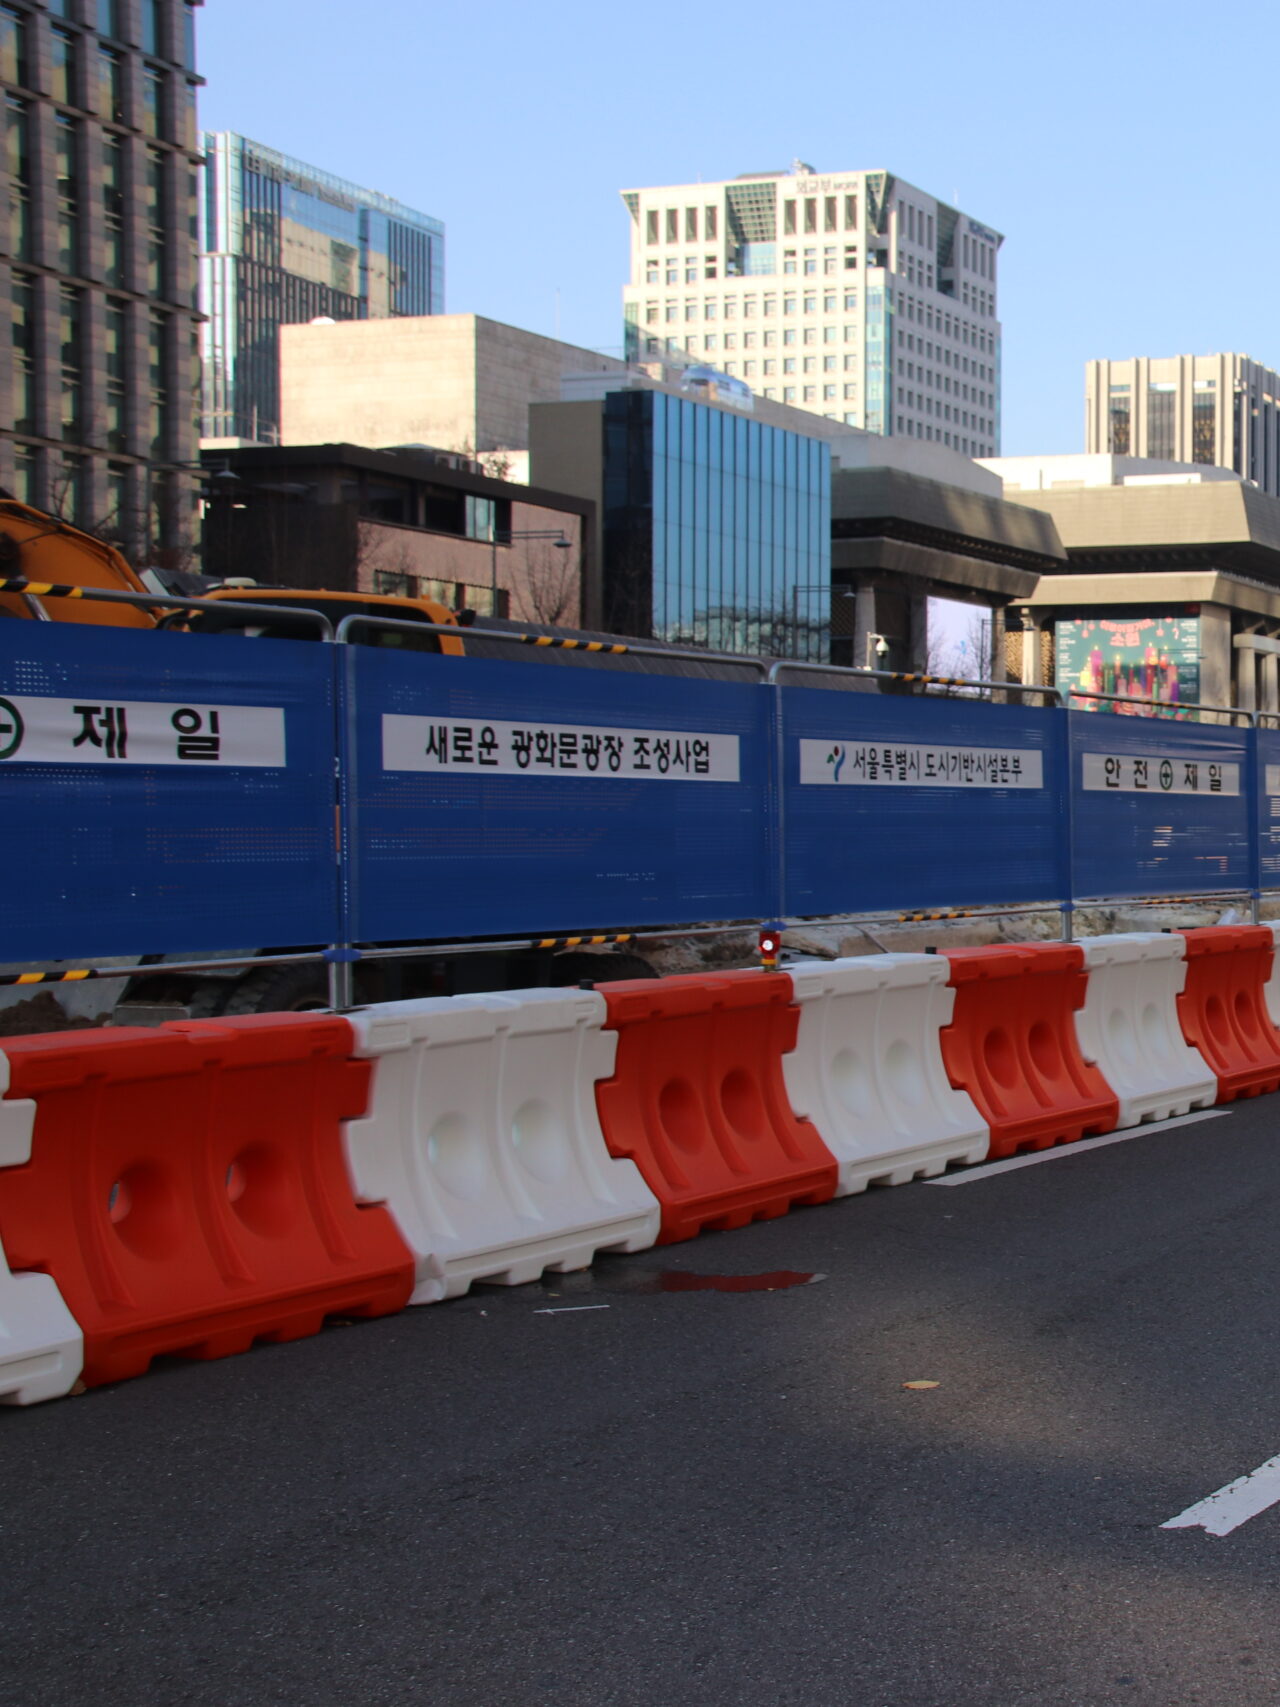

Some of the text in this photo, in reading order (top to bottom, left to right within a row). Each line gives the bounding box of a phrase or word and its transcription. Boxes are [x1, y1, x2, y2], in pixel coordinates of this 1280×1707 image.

[425, 725, 710, 773] 새로운 광화문광장 조성사업
[853, 748, 1022, 783] 서울특별시 도시기반시설본부
